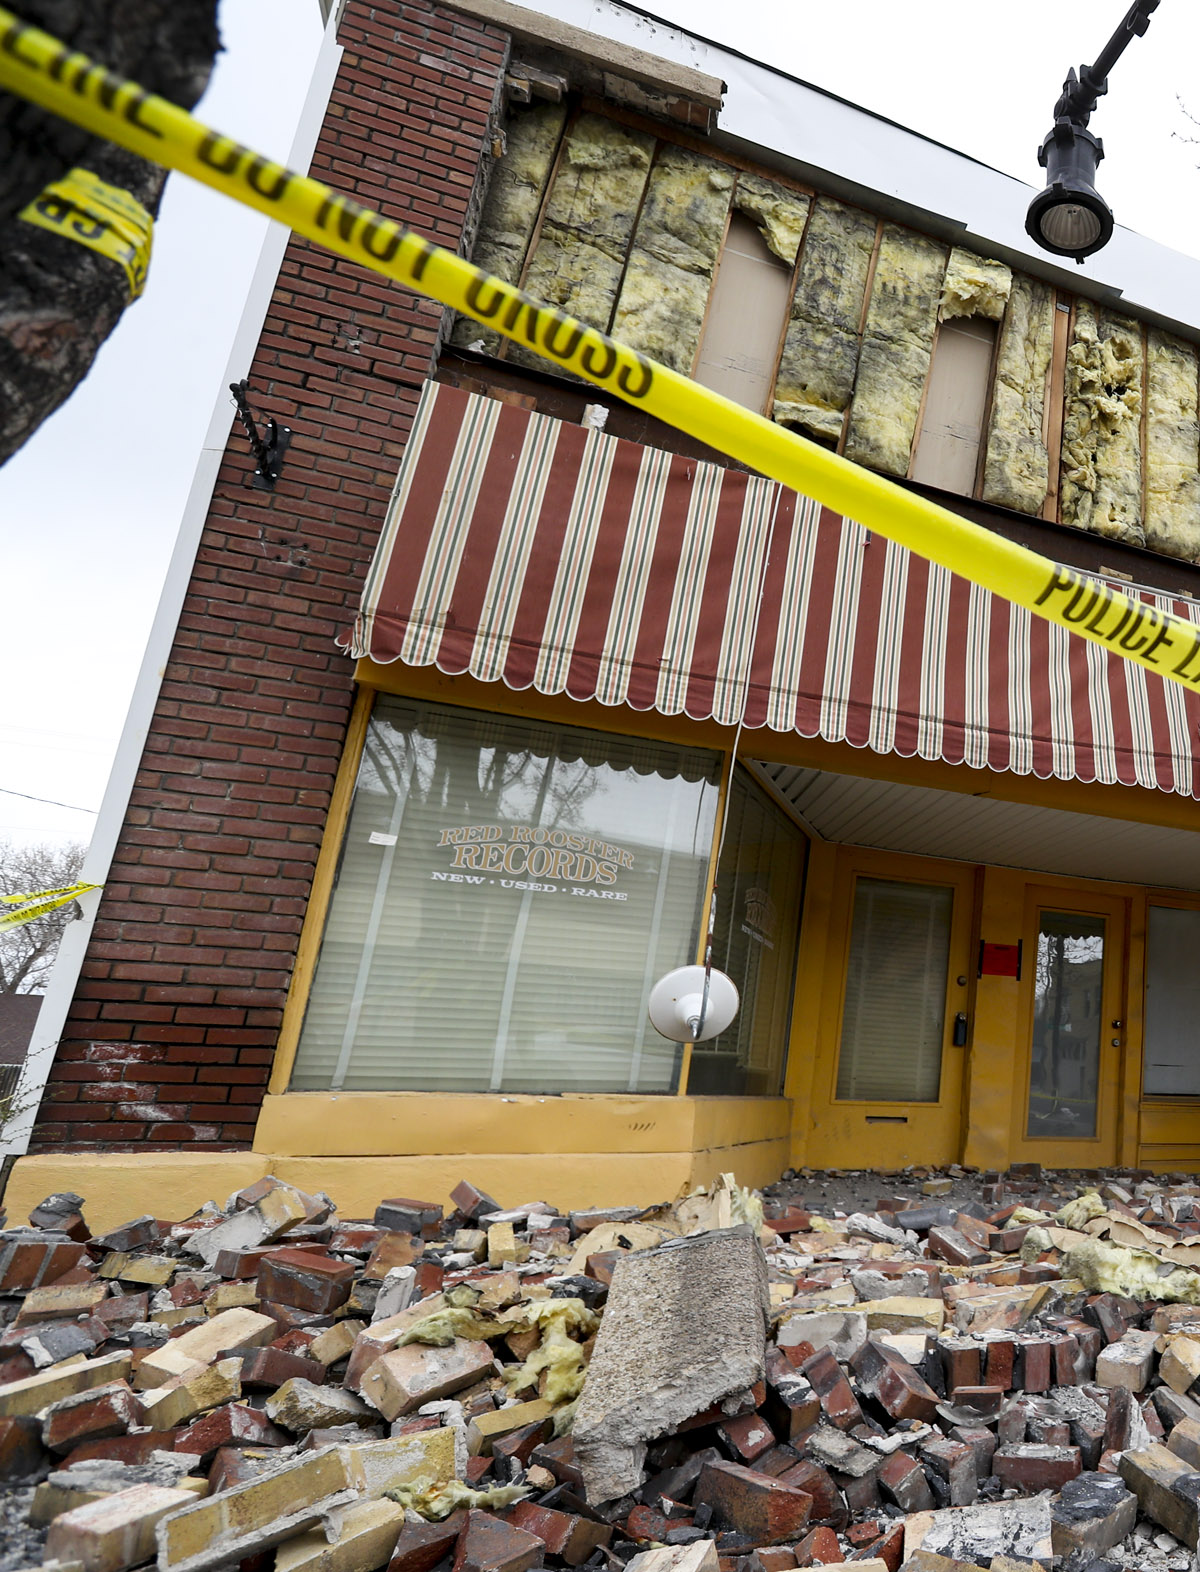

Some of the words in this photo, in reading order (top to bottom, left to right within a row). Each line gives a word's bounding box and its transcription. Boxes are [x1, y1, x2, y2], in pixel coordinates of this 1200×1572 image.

[1034, 563, 1181, 664] POLICE
[436, 824, 502, 847] RED
[508, 825, 635, 870] ROOSTER
[450, 843, 618, 885] RECORDS
[430, 871, 486, 885] NEW
[500, 879, 557, 893] USED
[571, 887, 628, 901] RARE
